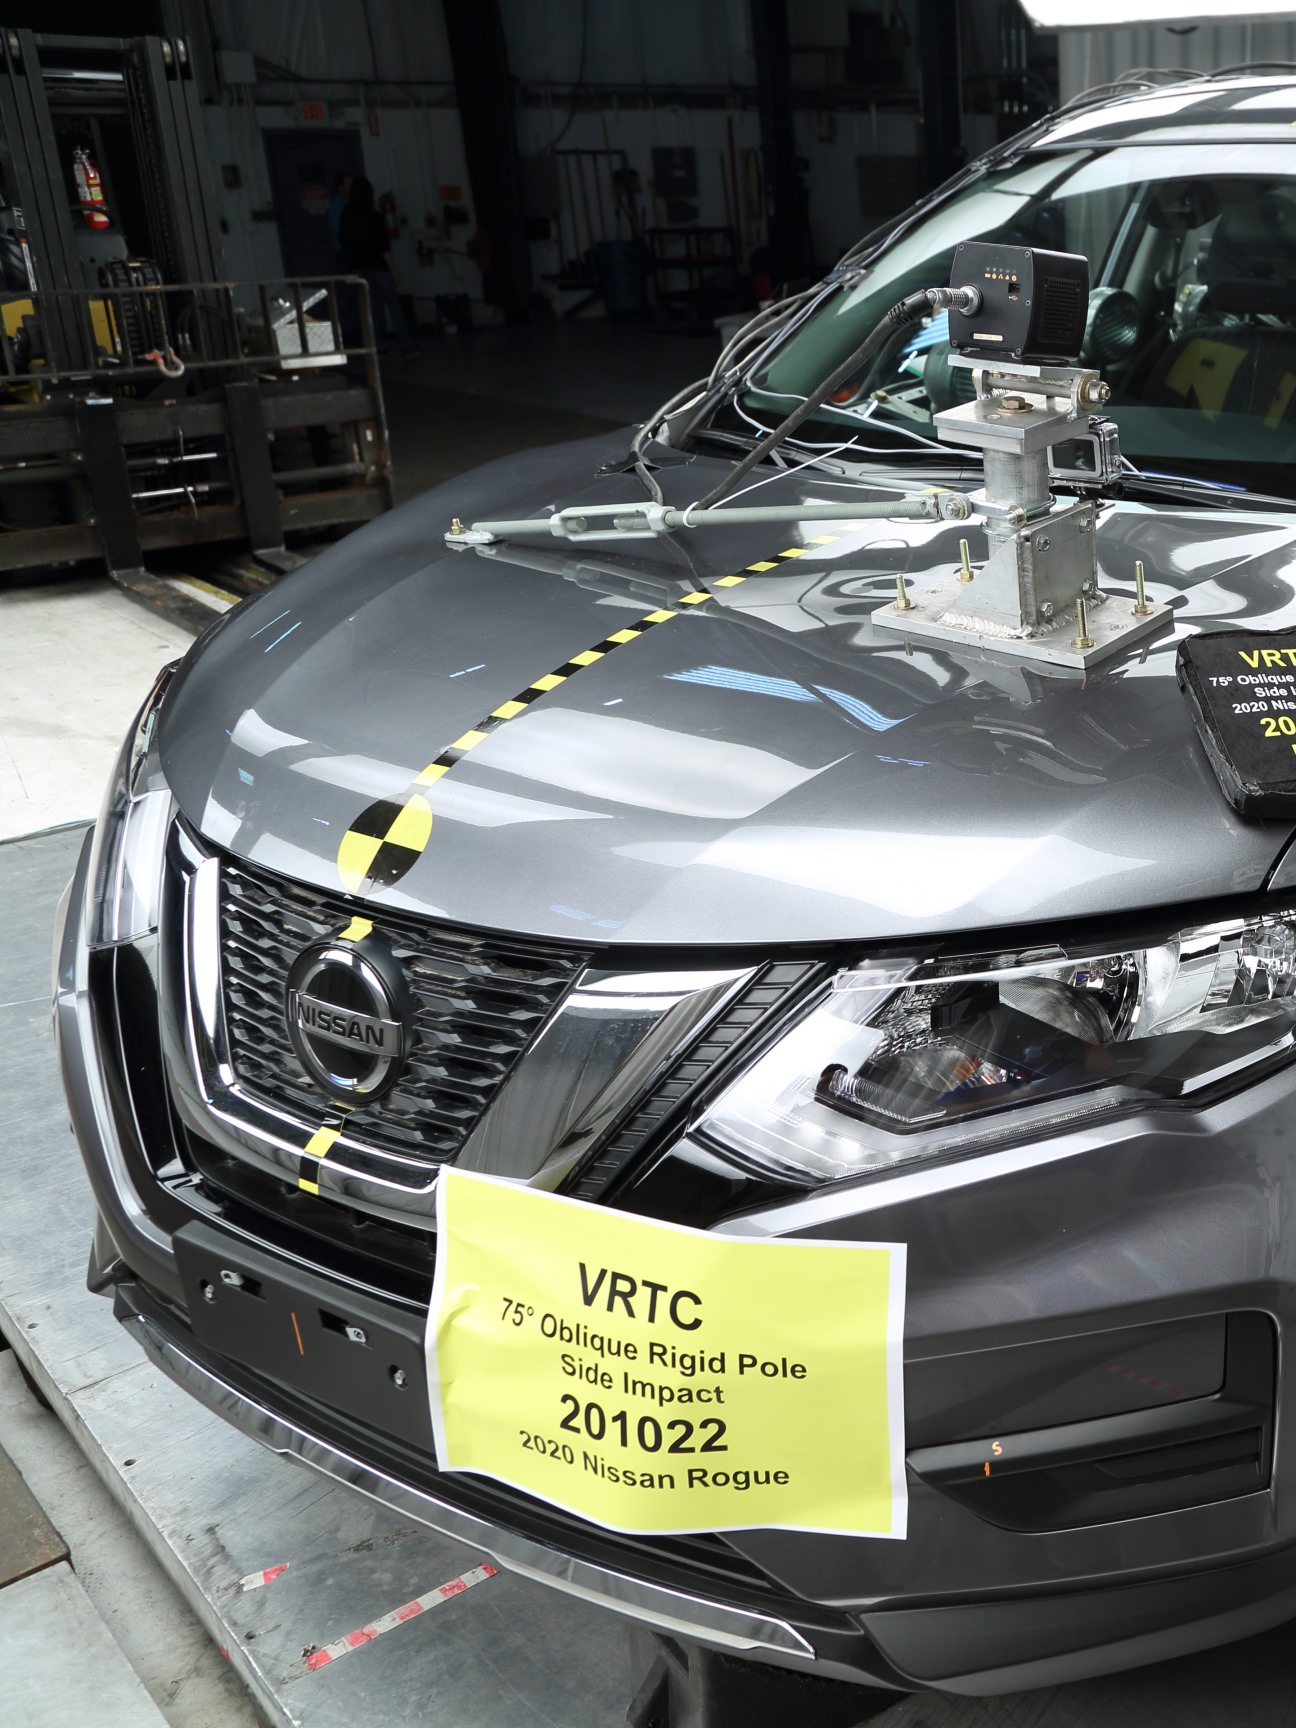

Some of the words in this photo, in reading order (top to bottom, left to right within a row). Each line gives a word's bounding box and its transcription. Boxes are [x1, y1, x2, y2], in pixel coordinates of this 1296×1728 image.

[1236, 673, 1295, 686] Oblique
[1254, 685, 1289, 698] Side
[1231, 701, 1269, 714] 2020
[297, 1001, 385, 1048] NISSAN
[577, 1261, 704, 1331] VRTC
[501, 1297, 535, 1328] 75°
[540, 1313, 638, 1361] Oblique
[649, 1341, 727, 1378] Rigid
[738, 1353, 808, 1381] Pole
[560, 1353, 614, 1391] Side
[622, 1371, 726, 1408] Impact
[559, 1393, 729, 1455] 201022
[519, 1430, 574, 1465] 2020
[583, 1451, 675, 1489] Nissan
[687, 1468, 790, 1491] Rogue
